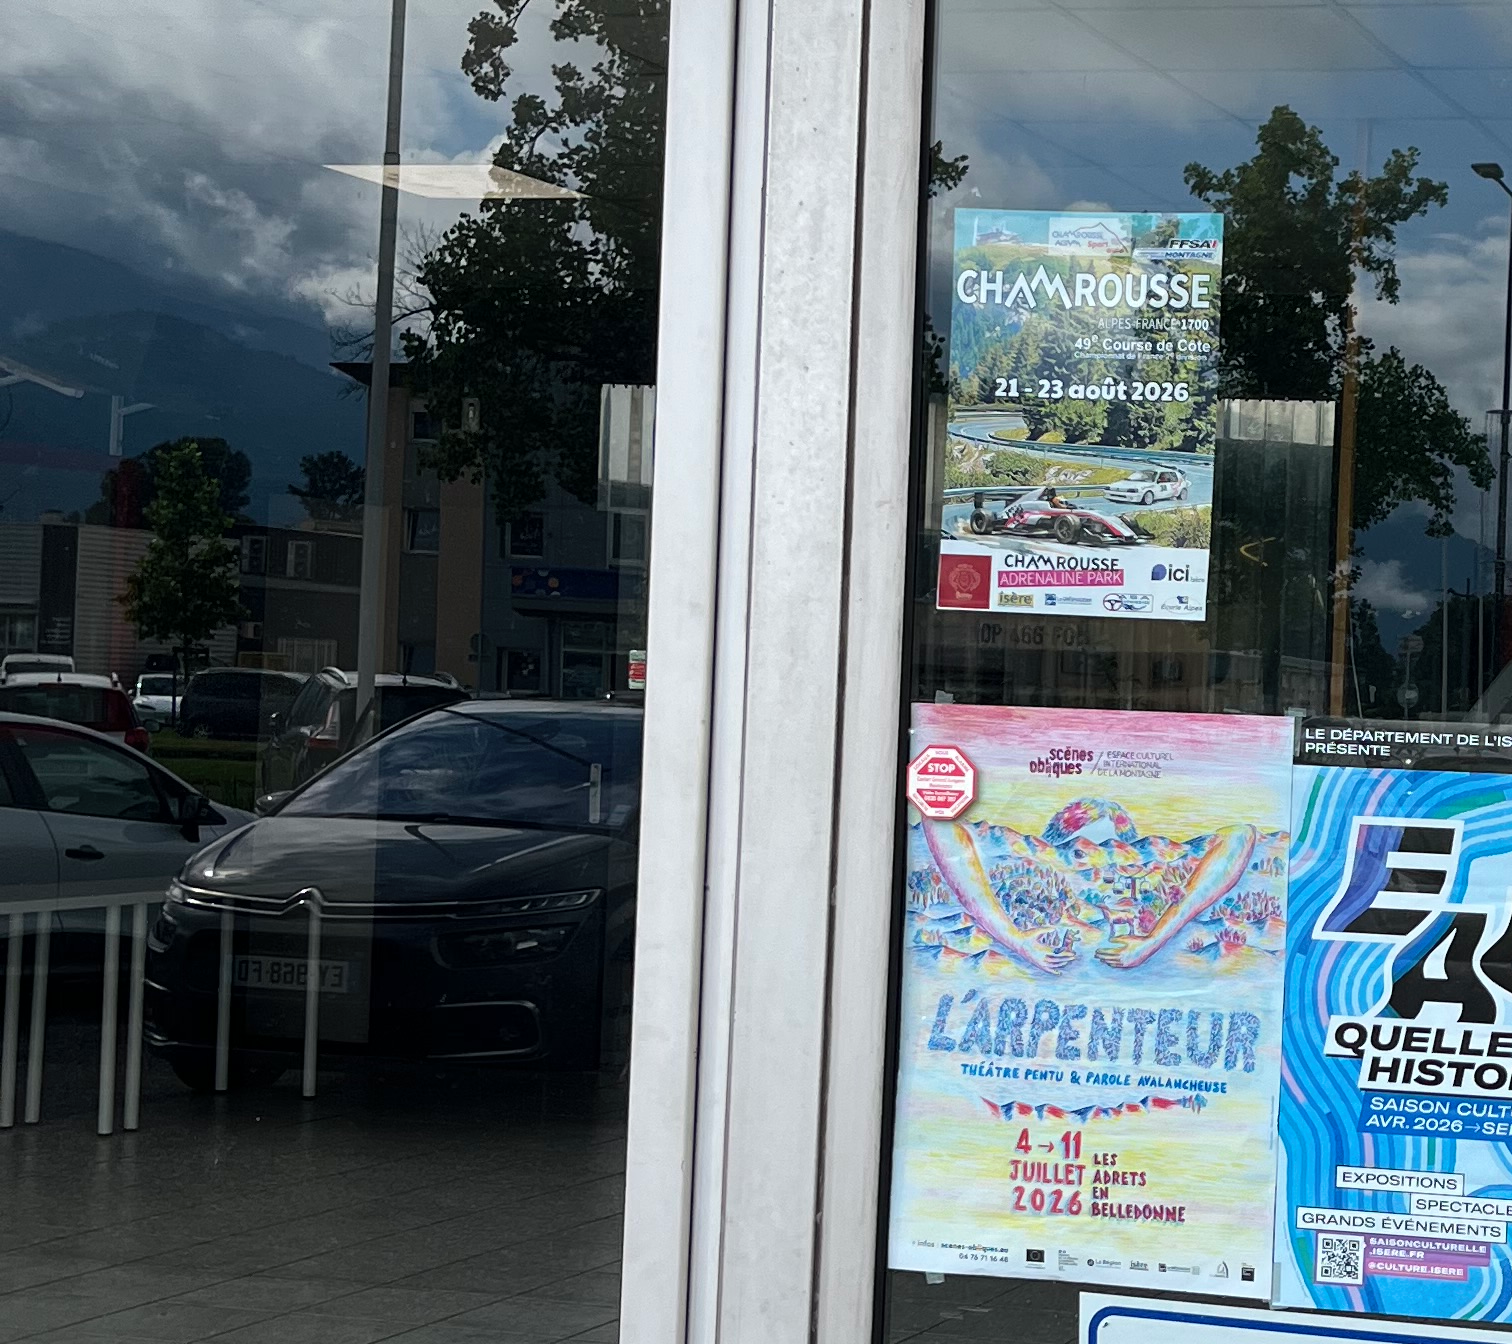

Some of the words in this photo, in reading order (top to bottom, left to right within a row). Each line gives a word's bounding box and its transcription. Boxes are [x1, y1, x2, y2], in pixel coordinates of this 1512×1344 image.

[1169, 239, 1211, 249] FFSA
[957, 264, 1211, 309] CHAMROUSSE
[1181, 319, 1209, 331] 1700
[1102, 338, 1153, 352] Course
[1156, 340, 1174, 352] de
[995, 378, 1019, 397] 21
[1038, 380, 1064, 399] 23
[1068, 376, 1128, 401] août
[1131, 381, 1189, 401] 2026
[1004, 554, 1120, 571] CHAMROUSSE
[1000, 571, 1083, 586] ADRENALINE
[1087, 570, 1122, 585] PARK
[1305, 728, 1326, 740] LE
[1330, 729, 1453, 745] DÉPARTEMENT
[1457, 734, 1480, 746] DE
[1107, 750, 1135, 760] ESPACE
[1305, 742, 1391, 757] PRÉSENTE
[927, 762, 956, 773] STOP
[927, 988, 1261, 1073] L'ARPENTEUR
[960, 1061, 1020, 1079] THÉÂTRE
[1024, 1068, 1063, 1083] PENTU
[1085, 1071, 1131, 1087] PAROLE
[1137, 1074, 1227, 1094] AVALANCHEUSE
[1370, 1097, 1451, 1116] SAISON
[1366, 1115, 1410, 1131] AVR.
[1015, 1127, 1032, 1155] 4
[1061, 1130, 1083, 1160] 11
[1093, 1153, 1118, 1167] LES
[1008, 1159, 1087, 1186] JUILLET
[1092, 1169, 1147, 1187] ADRETS
[1341, 1171, 1458, 1191] EXPOSITIONS
[1012, 1186, 1083, 1216] 2026
[1092, 1187, 1110, 1201] EN
[1090, 1202, 1187, 1223] BELLEDONNE
[1301, 1212, 1376, 1230] GRANDS
[1381, 1215, 1502, 1238] ÉVÉNEMENTS
[1369, 1237, 1488, 1254] SAISONCULTURELLE
